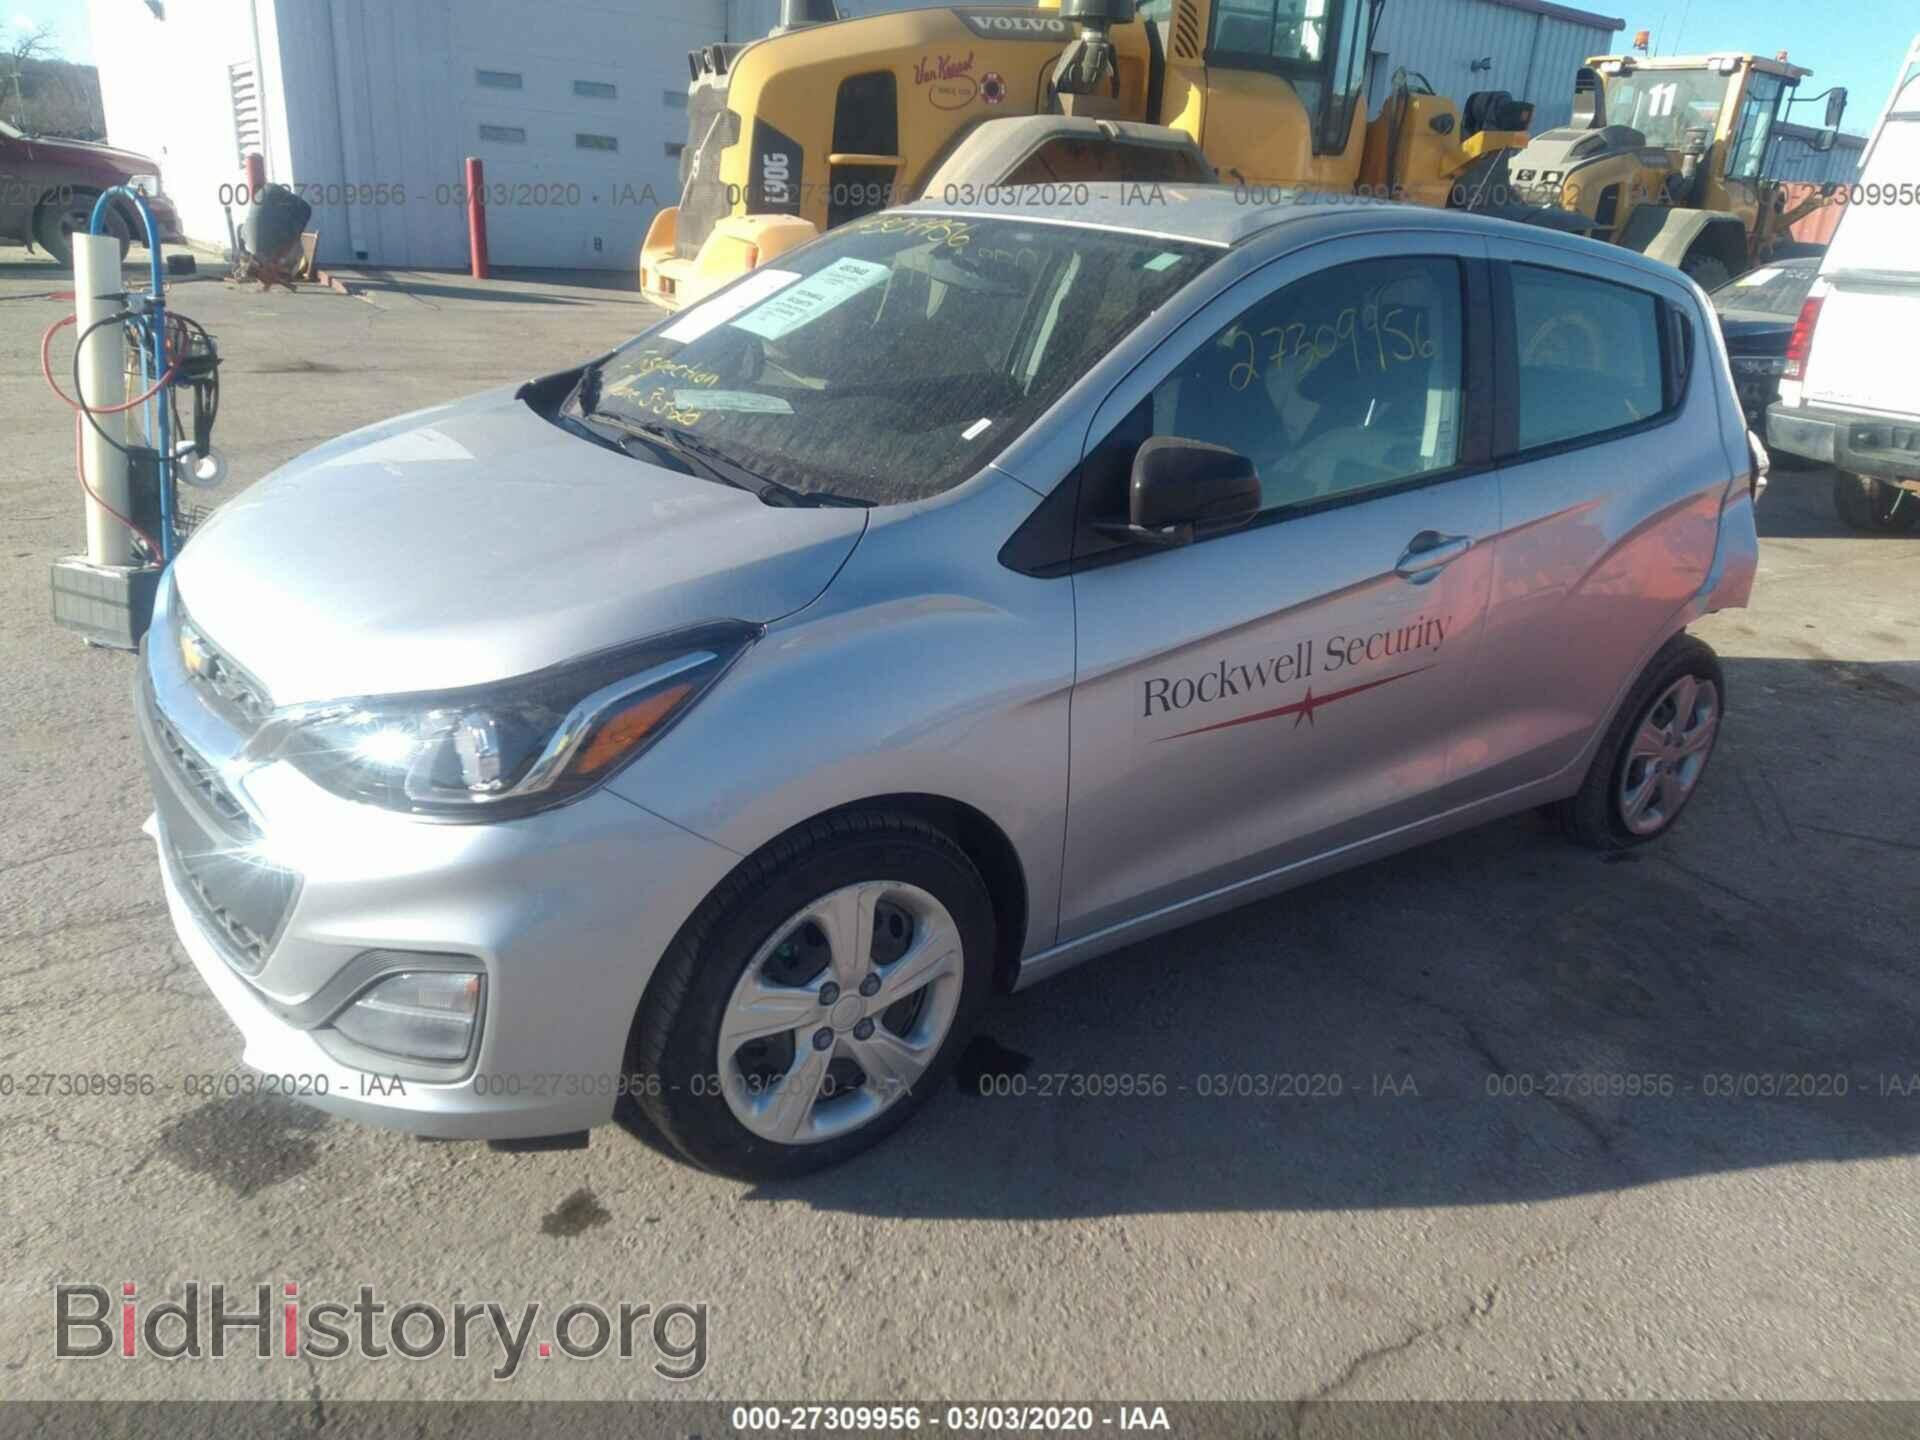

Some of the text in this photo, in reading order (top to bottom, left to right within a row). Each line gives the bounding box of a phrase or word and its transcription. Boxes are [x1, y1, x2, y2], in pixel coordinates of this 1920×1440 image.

[970, 15, 1066, 33] VOLVO
[1648, 82, 1678, 117] 11
[763, 152, 789, 203] L90G
[1228, 284, 1435, 392] 27309956
[1142, 615, 1453, 718] Rockwell Security
